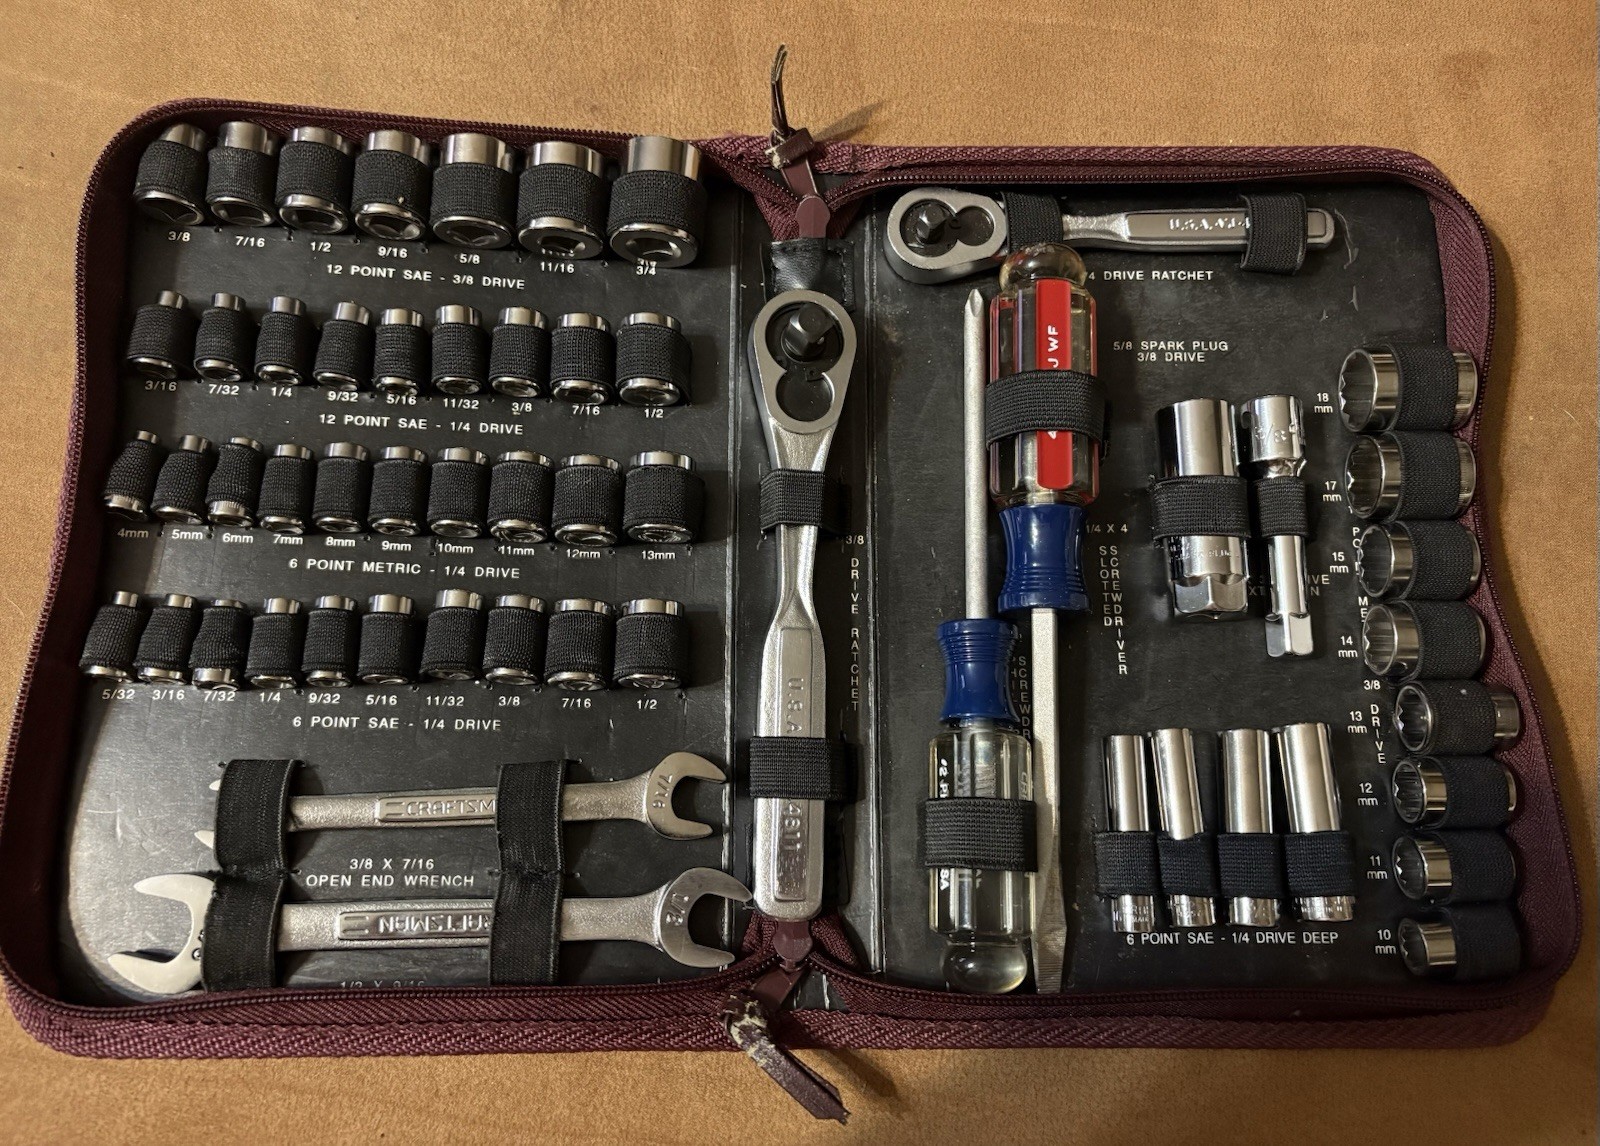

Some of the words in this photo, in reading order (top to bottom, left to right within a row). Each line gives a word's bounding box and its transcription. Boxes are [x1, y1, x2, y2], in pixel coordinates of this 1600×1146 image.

[168, 232, 190, 242] 3/8
[235, 235, 266, 248] 7/16
[310, 241, 332, 252] 1/2
[378, 246, 408, 258] 9/16
[459, 254, 480, 265] 5/8
[540, 262, 575, 274] 11/16
[636, 266, 656, 276] 3/4
[326, 264, 342, 274] 12
[350, 265, 396, 279] POINT
[403, 269, 432, 282] SAE
[452, 274, 474, 286] 3/8
[482, 276, 525, 290] DRIVE
[1103, 270, 1145, 281] DRIVE
[1151, 270, 1214, 282] RATCHET
[1113, 341, 1133, 352] 5/8
[1140, 341, 1184, 352] SPARK
[1192, 341, 1229, 352] PLUG
[1137, 352, 1157, 362] 3/8
[1165, 352, 1206, 363] DRIVE
[144, 380, 178, 392] 3/16
[208, 384, 240, 396] 7/32
[270, 386, 292, 398] 1/4
[327, 391, 359, 402] 9/32
[1316, 393, 1329, 402] 18
[386, 394, 417, 406] 5/16
[442, 398, 479, 410] 11/32
[511, 402, 532, 412] 3/8
[572, 404, 600, 416] 7/16
[1314, 406, 1333, 414] mm
[644, 408, 664, 419] 1/2
[319, 413, 336, 425] 12
[343, 414, 390, 428] POINT
[398, 418, 428, 430] SAE
[450, 421, 471, 432] 1/4
[479, 422, 523, 435] DRIVE
[1324, 481, 1337, 490] 17
[1322, 494, 1342, 502] mm
[117, 528, 149, 538] 4mm
[171, 528, 204, 540] 5mm
[1086, 524, 1101, 534] 1/4
[1107, 524, 1115, 533] X
[1120, 524, 1128, 533] 4
[222, 532, 254, 544] 6mm
[273, 534, 304, 545] 7mm
[325, 536, 356, 547] 8mm
[846, 535, 865, 544] 3/8
[381, 540, 412, 552] 9mm
[437, 542, 474, 554] 10mm
[500, 545, 535, 556] 11mm
[566, 548, 601, 559] 12mm
[641, 549, 676, 560] 13mm
[1332, 552, 1344, 562] 15
[288, 558, 298, 569] 6
[306, 558, 355, 572] POINT
[362, 561, 421, 574] METRIC
[444, 564, 466, 576] 1/4
[474, 566, 520, 579] DRIVE
[1329, 564, 1349, 574] mm
[851, 558, 860, 614] DRIVE
[1099, 545, 1112, 627] SLOTTED
[1109, 545, 1128, 675] SCREWDRIVER
[1340, 636, 1353, 645] 14
[1338, 649, 1358, 658] mm
[851, 628, 860, 711] RATCHET
[1363, 681, 1381, 690] 3/8
[101, 689, 136, 700] 5/32
[152, 689, 185, 700] 3/16
[203, 690, 236, 702] 7/32
[259, 691, 282, 703] 1/4
[308, 692, 341, 704] 9/32
[365, 694, 398, 706] 5/16
[1018, 656, 1031, 740] SCREWDR
[426, 696, 465, 707] 11/32
[498, 696, 521, 706] 3/8
[562, 698, 592, 708] 7/16
[636, 699, 658, 710] 1/2
[1350, 711, 1362, 721] 13
[292, 716, 302, 728] 6
[310, 716, 360, 728] POINT
[368, 717, 399, 729] SAE
[423, 718, 445, 730] 1/4
[454, 718, 501, 731] DRIVE
[1348, 725, 1368, 734] mm
[1370, 704, 1386, 764] DRIVE
[1359, 783, 1373, 794] 12
[1357, 796, 1378, 806] mm
[407, 800, 496, 816] CRAFTSM
[350, 858, 373, 870] 3/8
[383, 858, 392, 869] X
[403, 858, 434, 870] 7/16
[1370, 856, 1381, 866] 11
[306, 874, 352, 887] OPEN
[361, 875, 394, 886] END
[404, 875, 474, 887] WRENCH
[1366, 870, 1388, 880] mm
[378, 914, 492, 933] RAFTSMAN
[1126, 934, 1134, 945] 6
[1141, 933, 1181, 945] POINT
[1187, 933, 1214, 945] SAE
[1232, 933, 1250, 944] 1/4
[1256, 932, 1296, 944] DRIVE
[1303, 932, 1339, 944] DEEP
[1377, 930, 1391, 940] 10
[1375, 944, 1397, 954] mm
